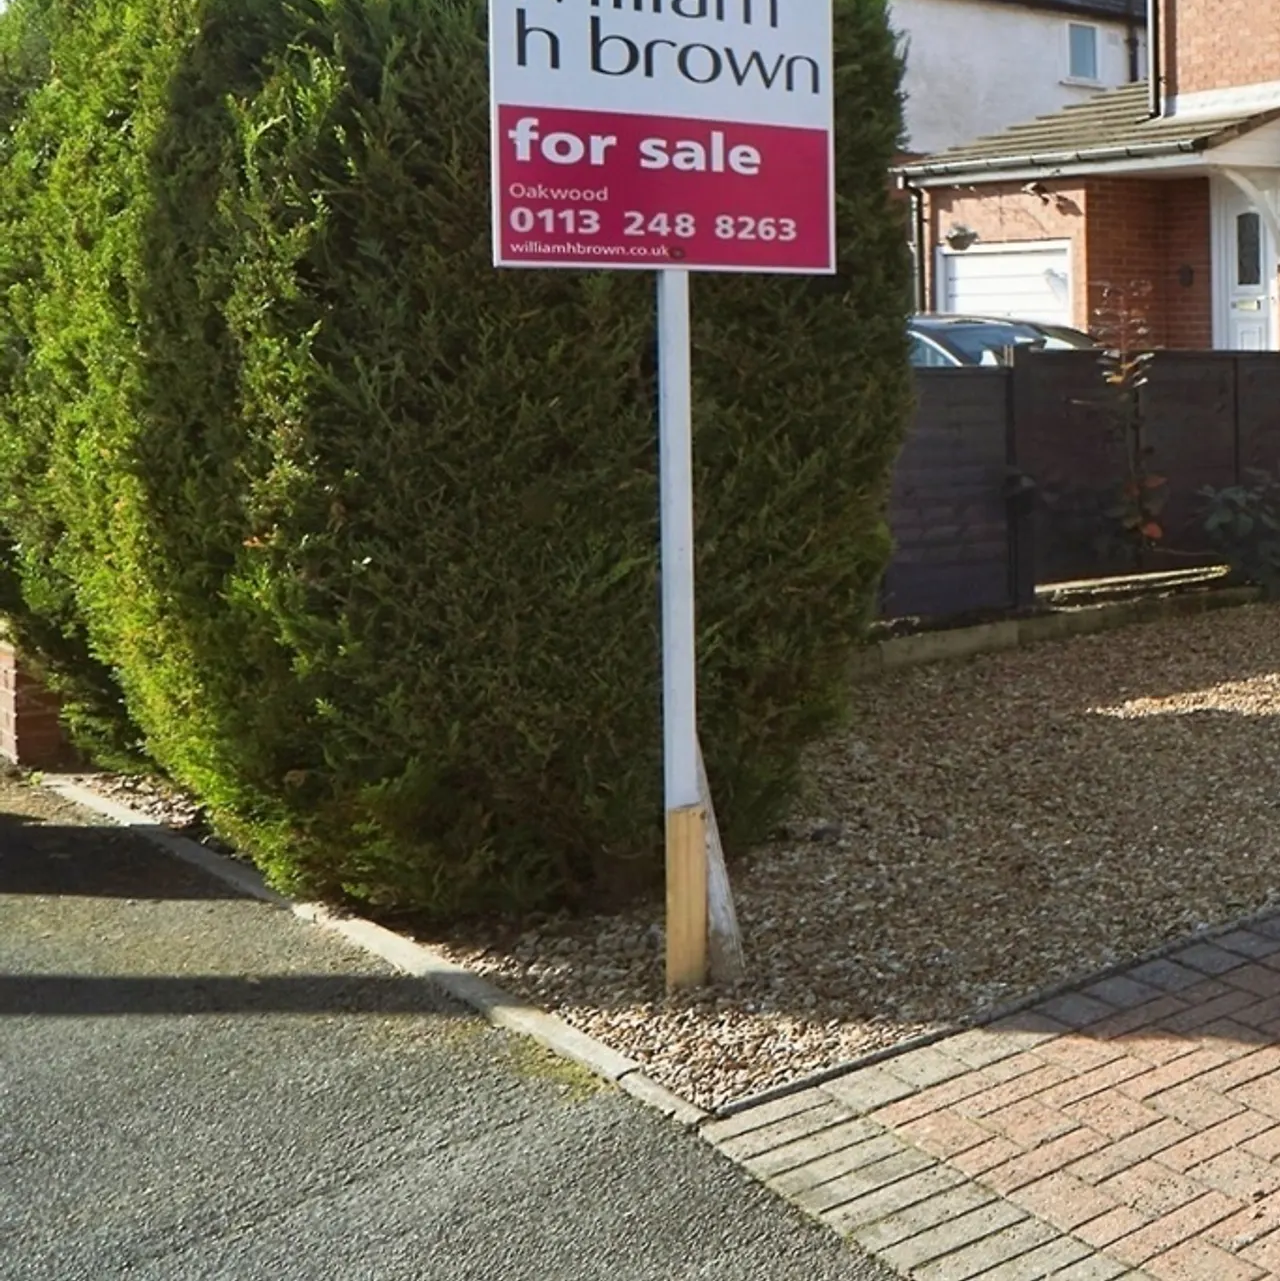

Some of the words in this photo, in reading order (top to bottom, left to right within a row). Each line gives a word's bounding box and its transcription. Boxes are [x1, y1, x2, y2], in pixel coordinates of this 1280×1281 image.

[516, 7, 561, 70] h
[590, 15, 820, 94] brown
[508, 117, 617, 166] for
[639, 130, 761, 175] sale
[509, 182, 609, 202] Oakwood
[510, 206, 601, 234] 0113
[623, 210, 696, 237] 248
[715, 215, 797, 241] 8263
[510, 240, 669, 258] williamhbrown.co.uk
